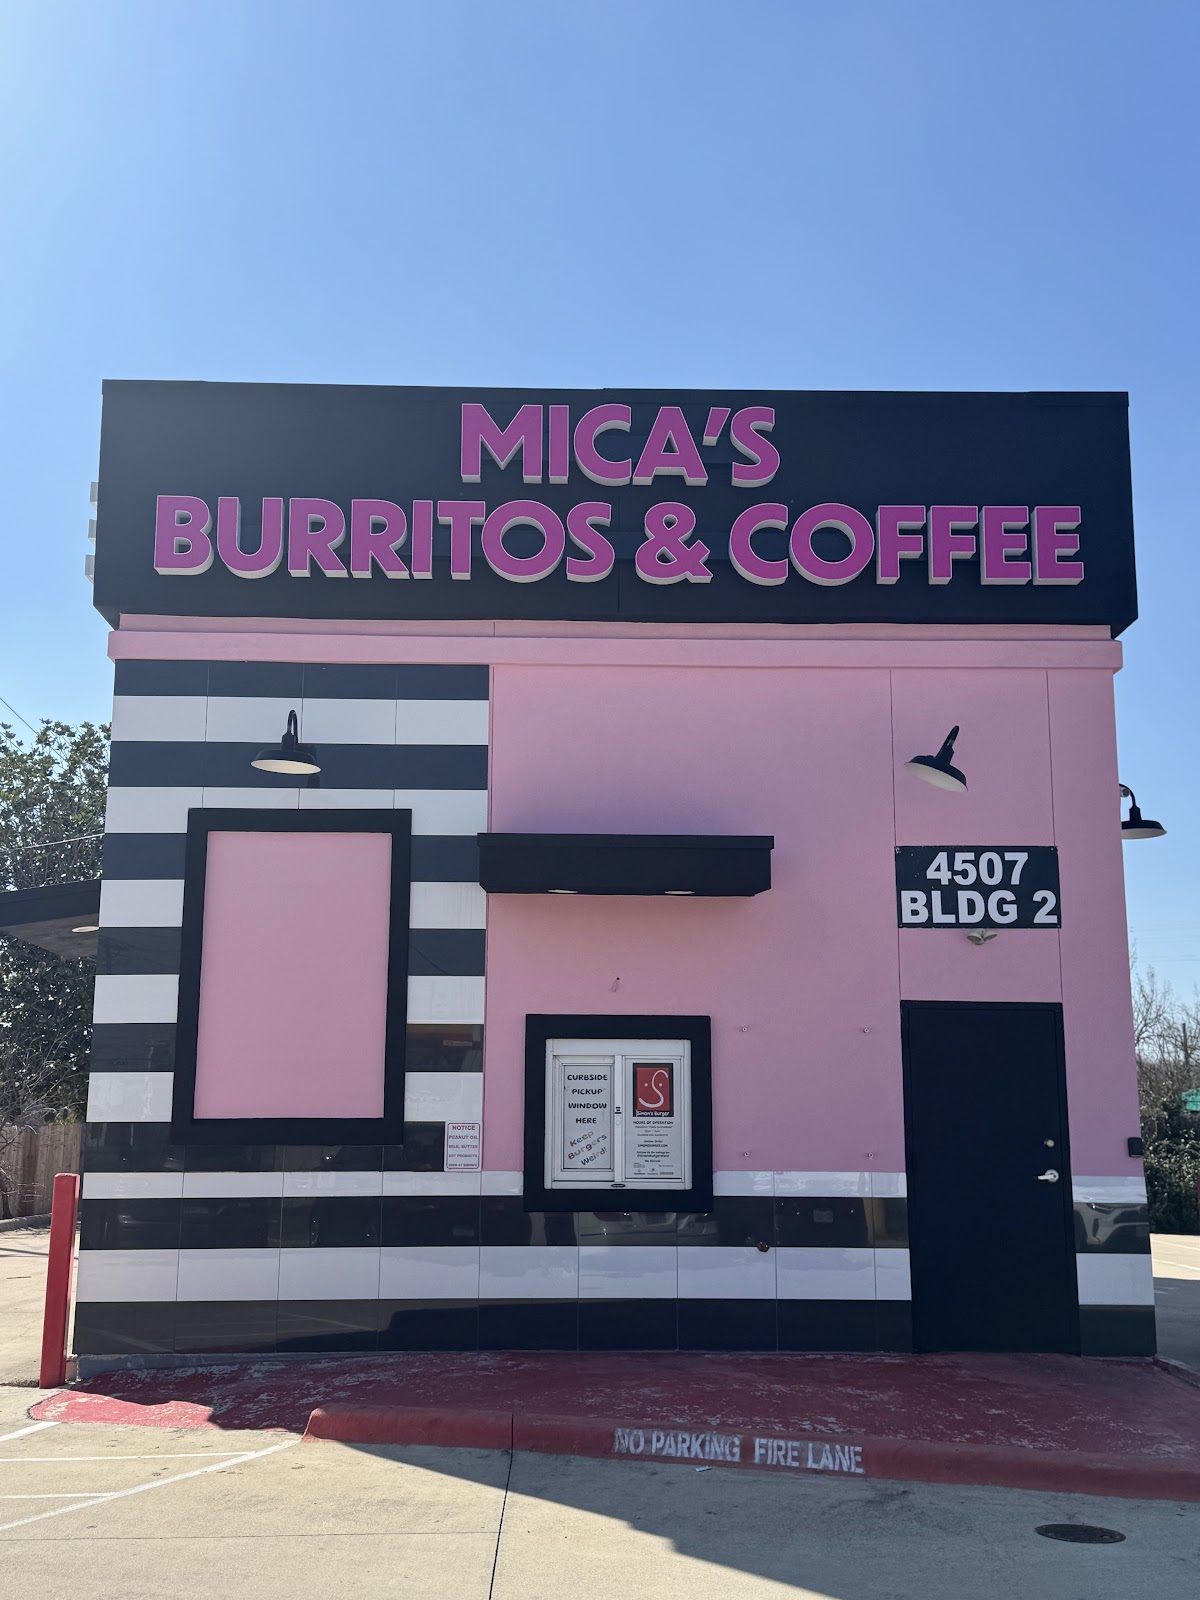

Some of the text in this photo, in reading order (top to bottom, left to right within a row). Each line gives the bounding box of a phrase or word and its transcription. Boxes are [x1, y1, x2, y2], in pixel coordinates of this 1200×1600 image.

[461, 403, 780, 488] MICA'S
[153, 495, 1085, 586] BURRITOS & COFFEE
[926, 851, 1028, 886] 4507
[900, 889, 1058, 924] BLDG 2
[568, 1134, 607, 1160] Burgers
[569, 1131, 594, 1147] Keep
[581, 1147, 608, 1166] Weird!
[614, 1428, 864, 1474] NO PARKING FIRE LANE
